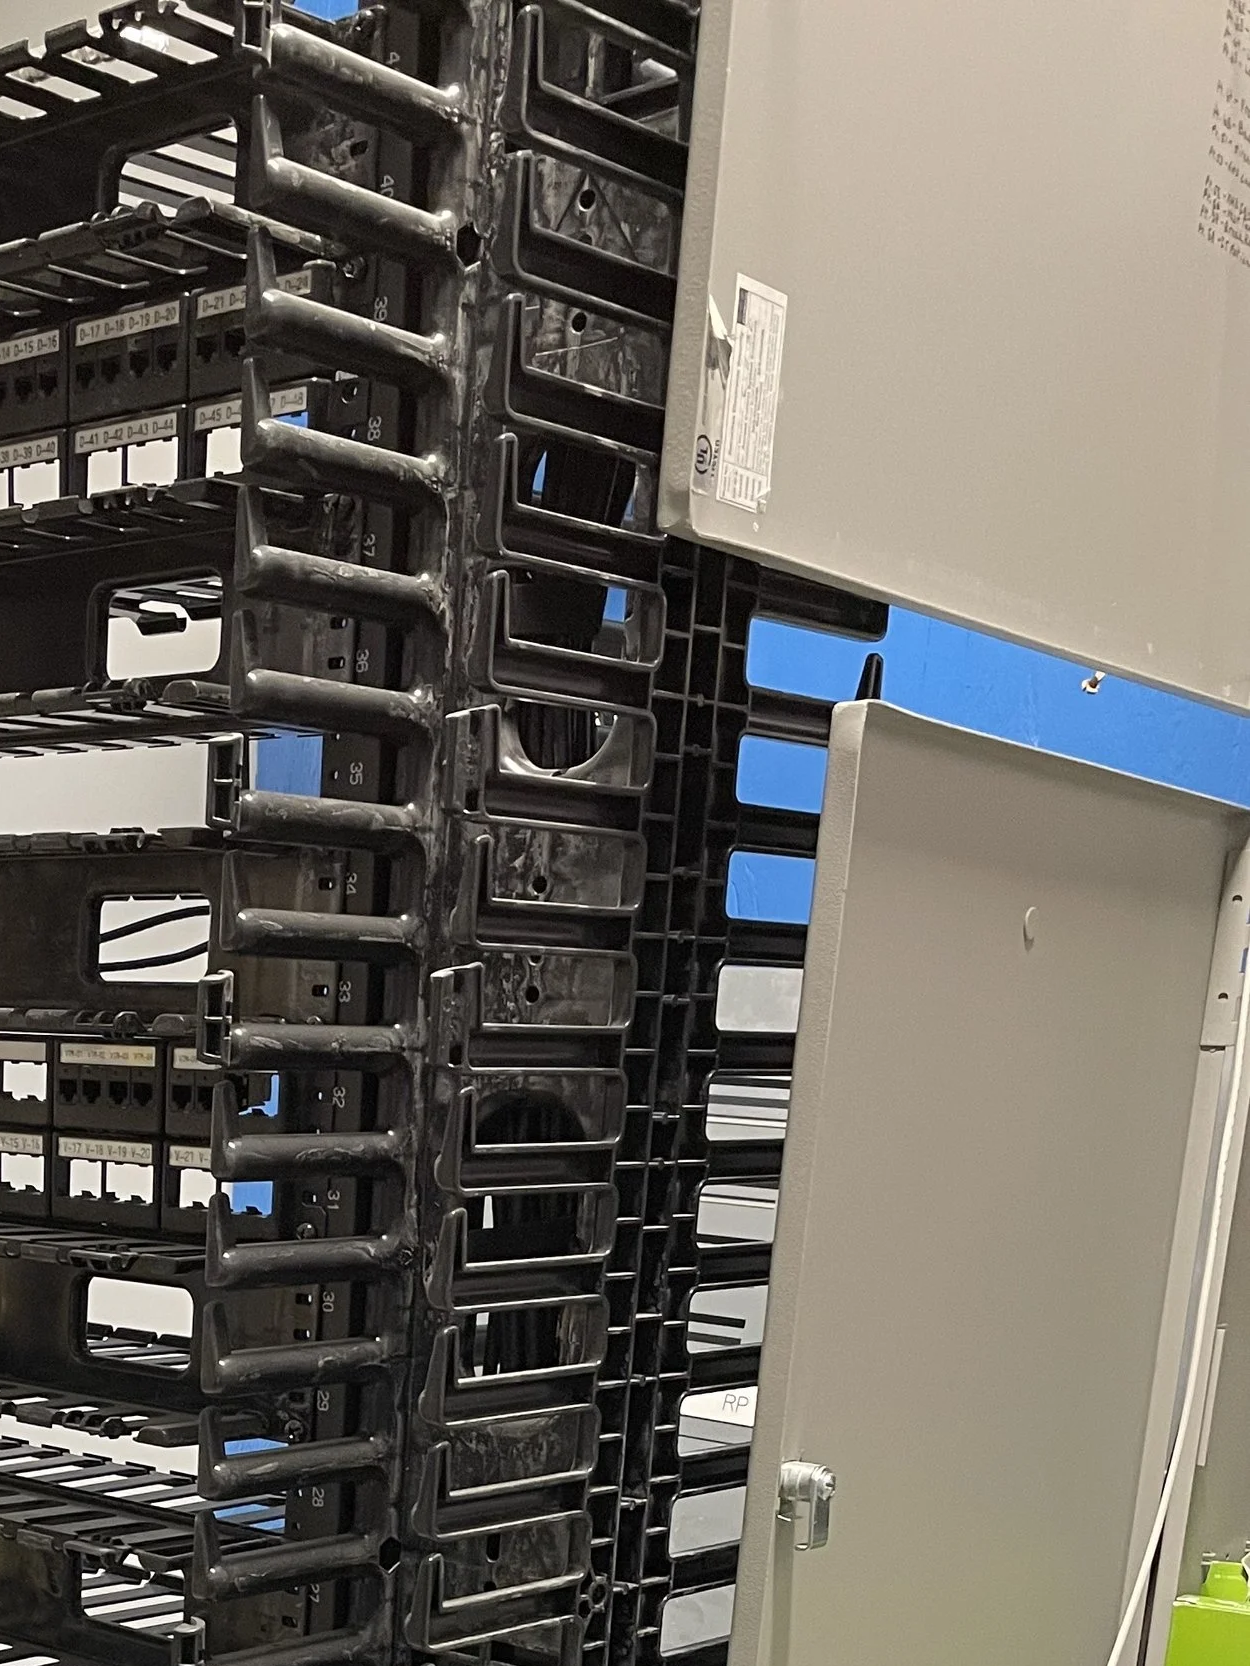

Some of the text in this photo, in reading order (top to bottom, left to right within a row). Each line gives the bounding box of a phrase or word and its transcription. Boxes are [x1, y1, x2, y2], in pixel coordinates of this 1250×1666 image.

[202, 296, 224, 311] D-21
[373, 296, 388, 323] 39
[79, 306, 177, 341] D-17 D-18 D-19 D-20
[13, 341, 33, 357] D-15
[36, 335, 57, 351] D-16
[200, 408, 222, 424] D-45
[79, 417, 174, 448] D-41 D-42 D-43 D-44
[367, 415, 382, 442] 38
[12, 445, 33, 462] D-39
[36, 440, 56, 456] D-40
[362, 533, 376, 557] 37
[355, 648, 370, 674] 36
[349, 762, 363, 786] 35
[344, 872, 358, 896] 34
[338, 980, 352, 1003] 33
[332, 1086, 346, 1109] 32
[1, 1137, 19, 1149] V-15
[63, 1143, 81, 1154] V-17
[107, 1145, 127, 1157] V-19
[131, 1147, 150, 1159] V-20
[174, 1150, 194, 1162] V-21
[327, 1190, 340, 1211] 31
[322, 1291, 335, 1313] 30
[317, 1390, 330, 1412] 29
[722, 1393, 749, 1413] RP
[312, 1487, 325, 1508] 28
[307, 1583, 320, 1604] 27
